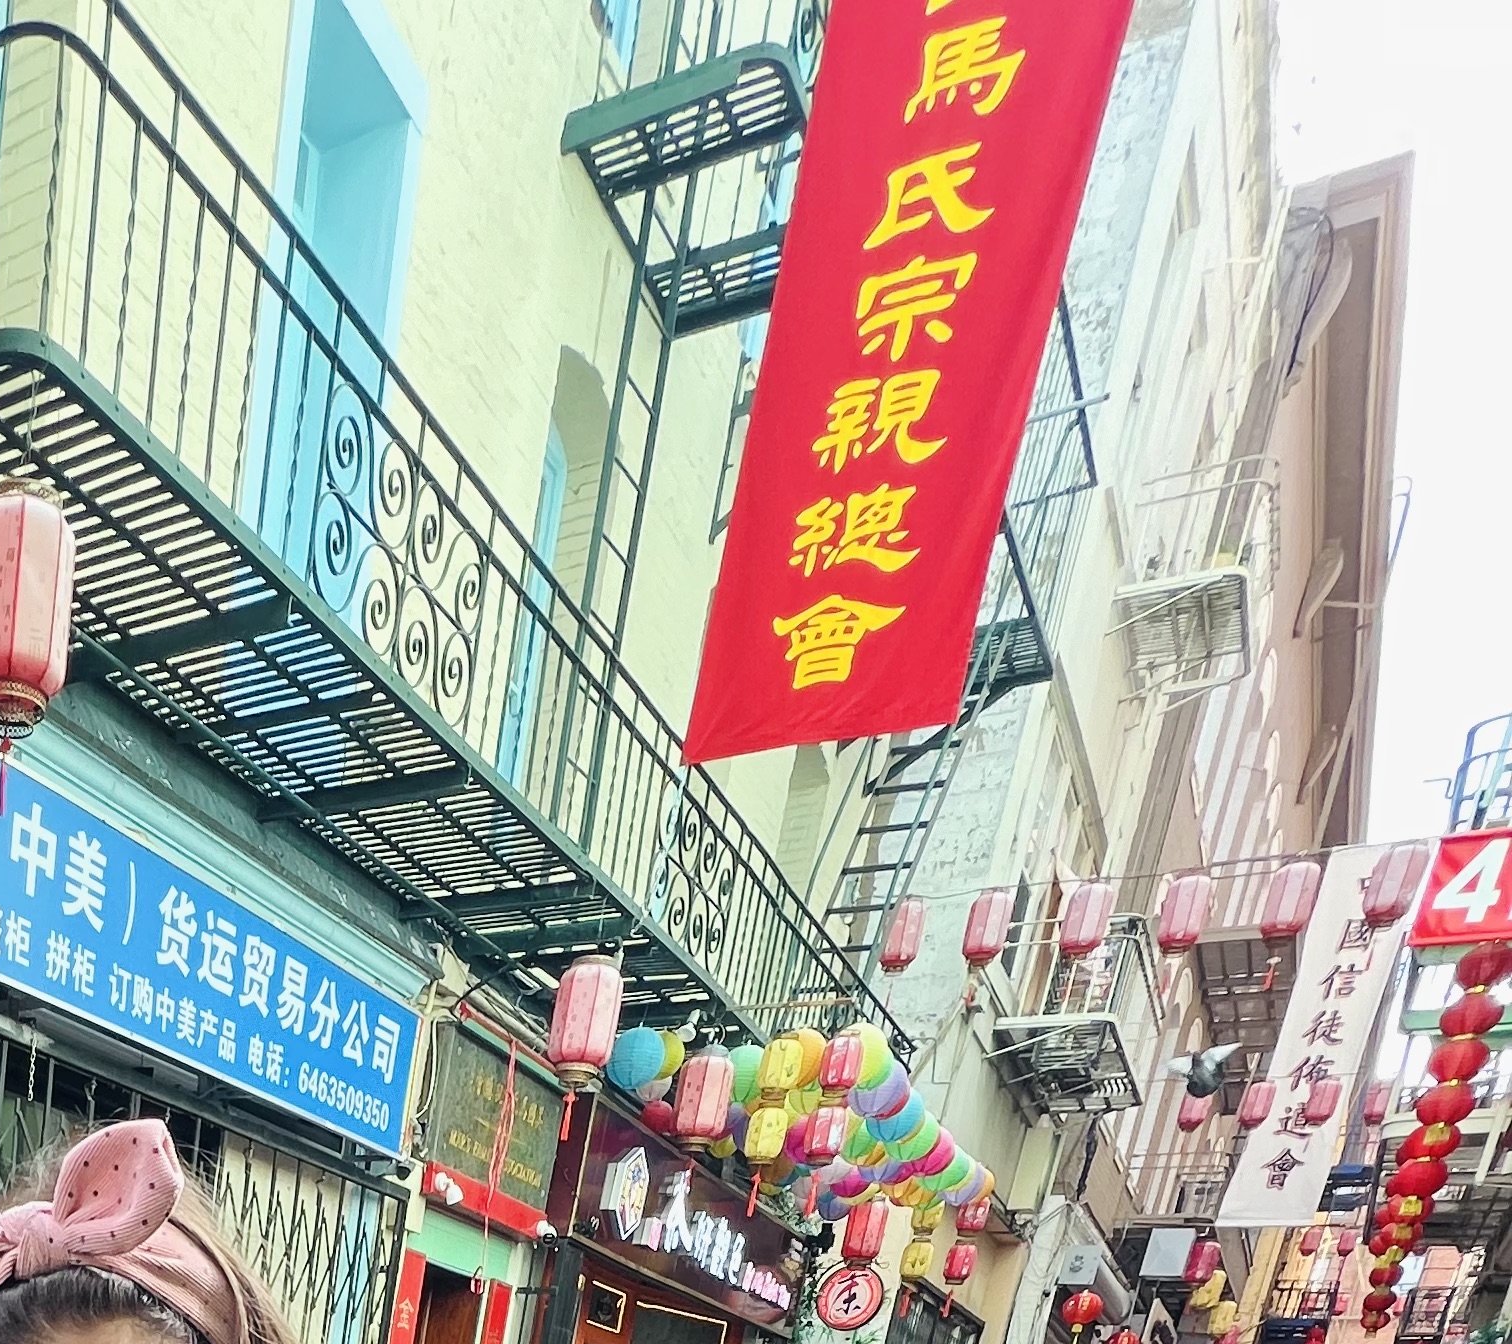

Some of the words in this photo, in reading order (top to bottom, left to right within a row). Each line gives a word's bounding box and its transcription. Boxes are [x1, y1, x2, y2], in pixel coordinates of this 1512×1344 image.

[773, 0, 1027, 691] 馬氏宗親總會
[46, 930, 96, 998] 拼柜
[109, 965, 236, 1064] 订购中美产品
[1262, 876, 1377, 1191] 國信徒佈道會
